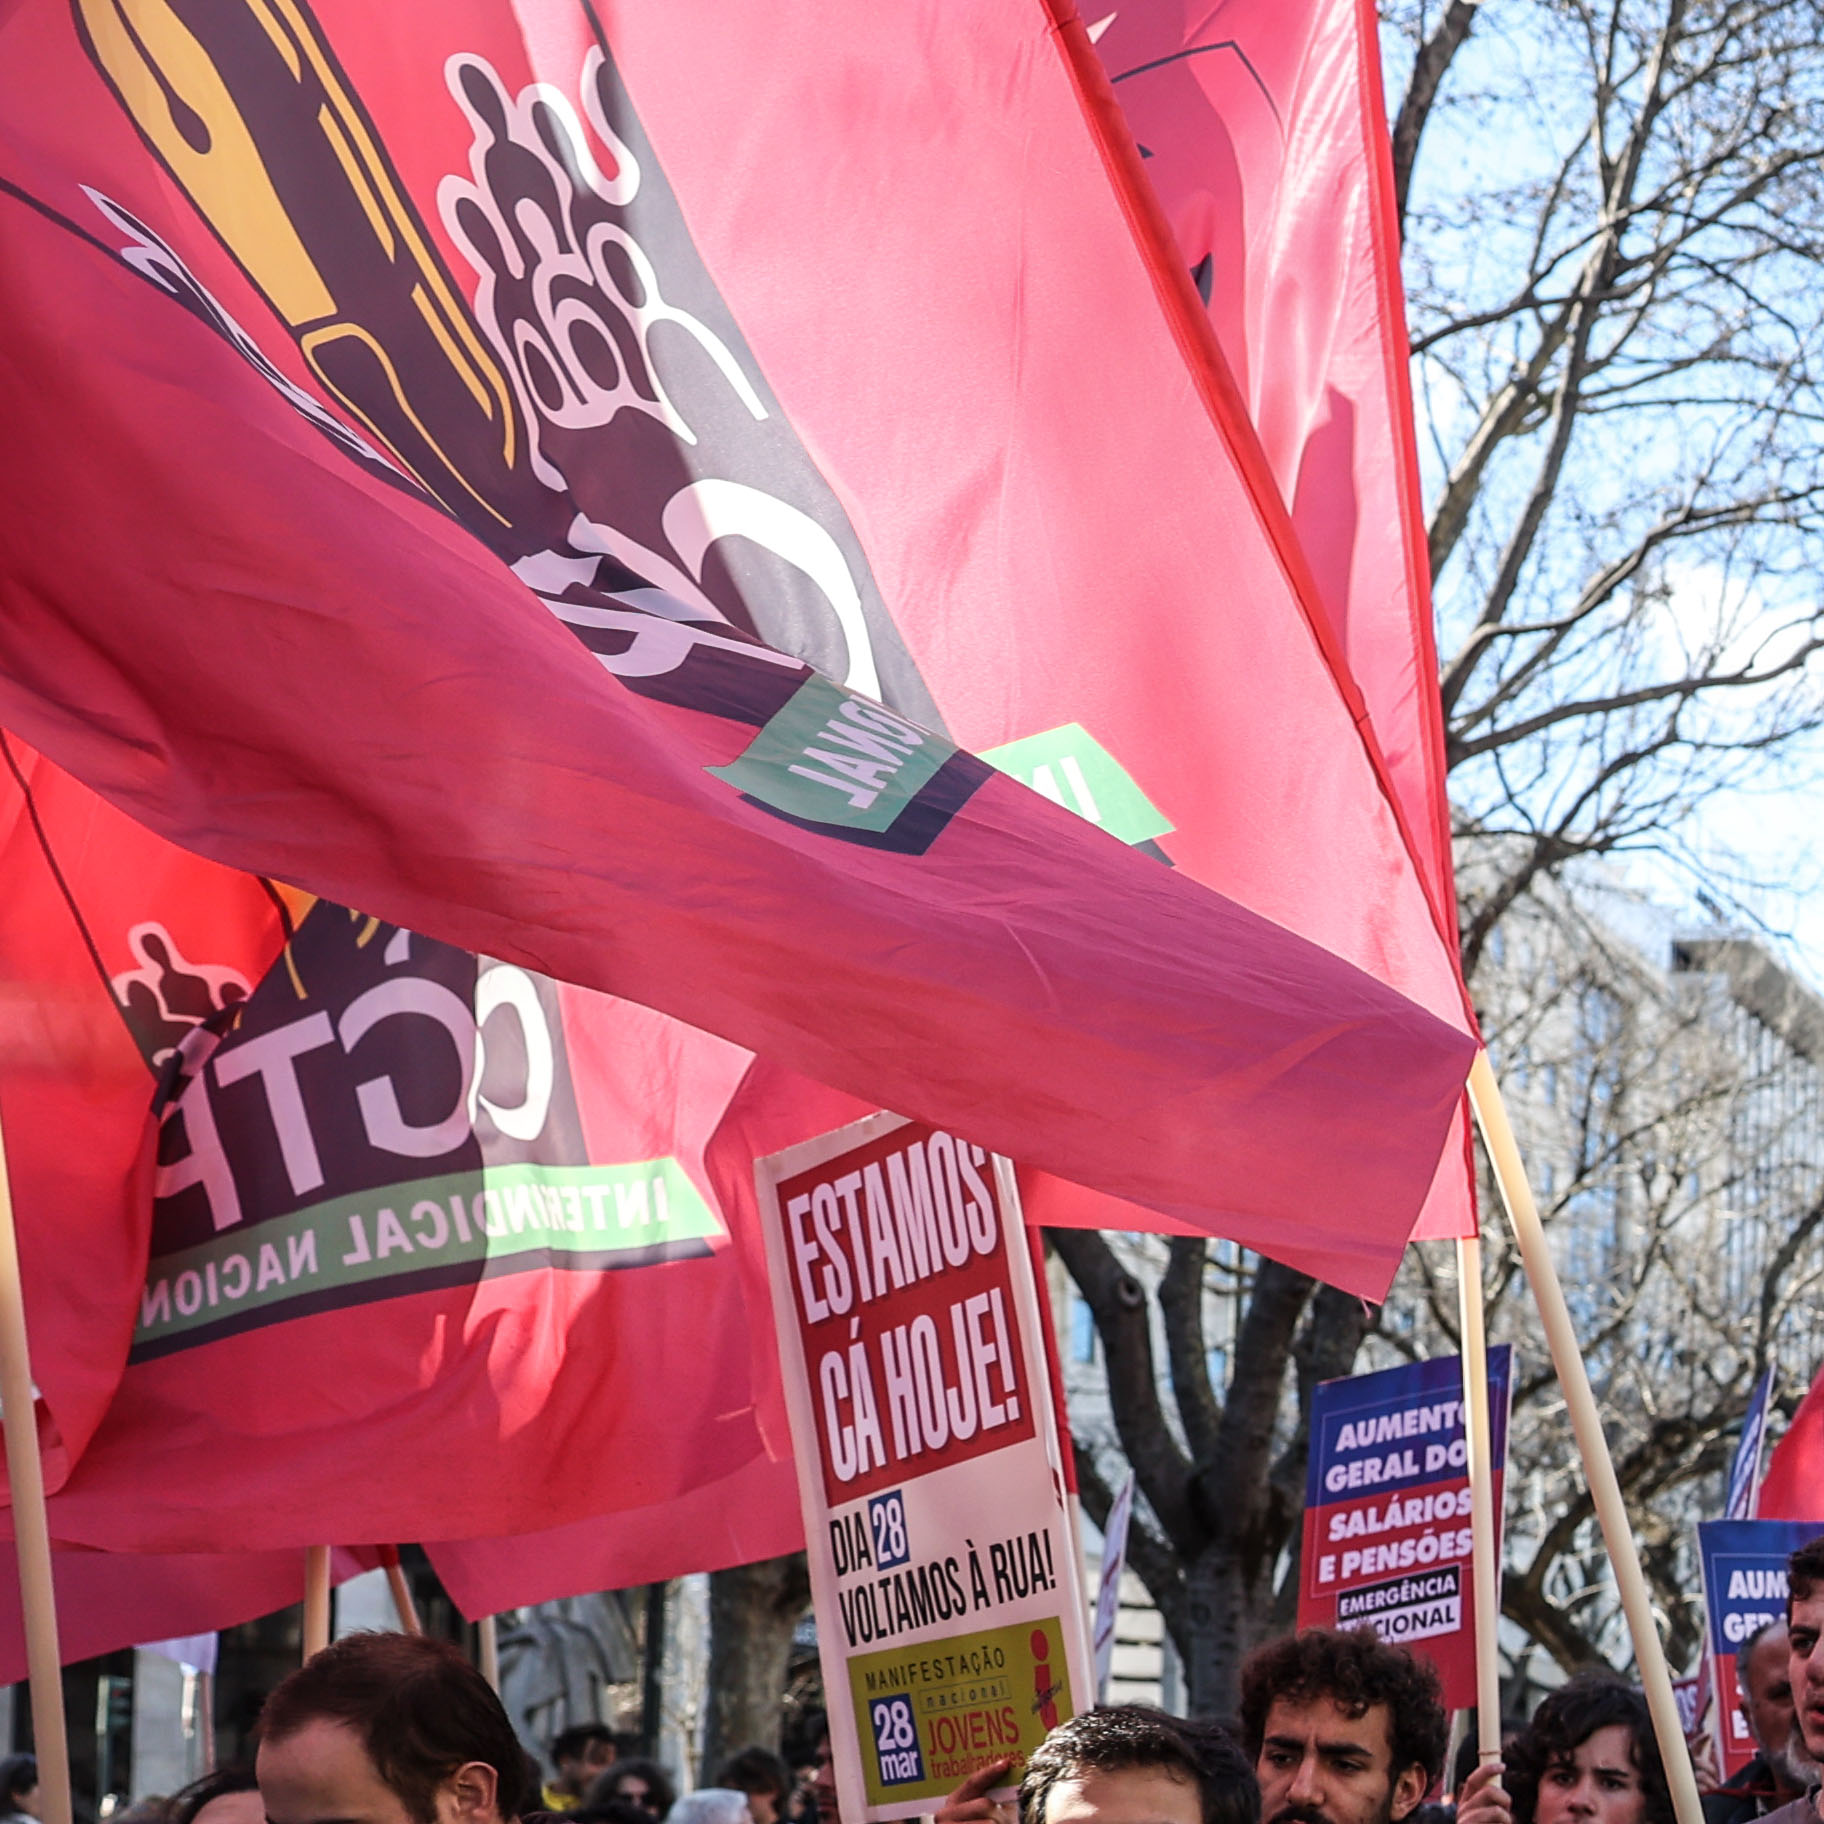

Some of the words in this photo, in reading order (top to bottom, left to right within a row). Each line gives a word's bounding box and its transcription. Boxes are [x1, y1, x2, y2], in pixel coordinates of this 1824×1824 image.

[788, 1131, 997, 1325] ESTAMOS
[820, 1316, 887, 1482] CÁ
[880, 1287, 1021, 1460] HOJE!
[1325, 1453, 1419, 1492] GERAL
[830, 1511, 873, 1577] DIA
[873, 1498, 907, 1565] 28
[839, 1557, 968, 1648] VOLTAMOS
[965, 1539, 991, 1611] À
[990, 1528, 1058, 1605] RUA!
[1318, 1555, 1336, 1584] E
[1339, 1573, 1456, 1617] EMERGÊNCIA
[865, 1646, 1006, 1692] MANIFESTAÇÃO
[874, 1701, 915, 1750] 28
[927, 1706, 1020, 1756] JOVENS
[881, 1752, 919, 1780] mar
